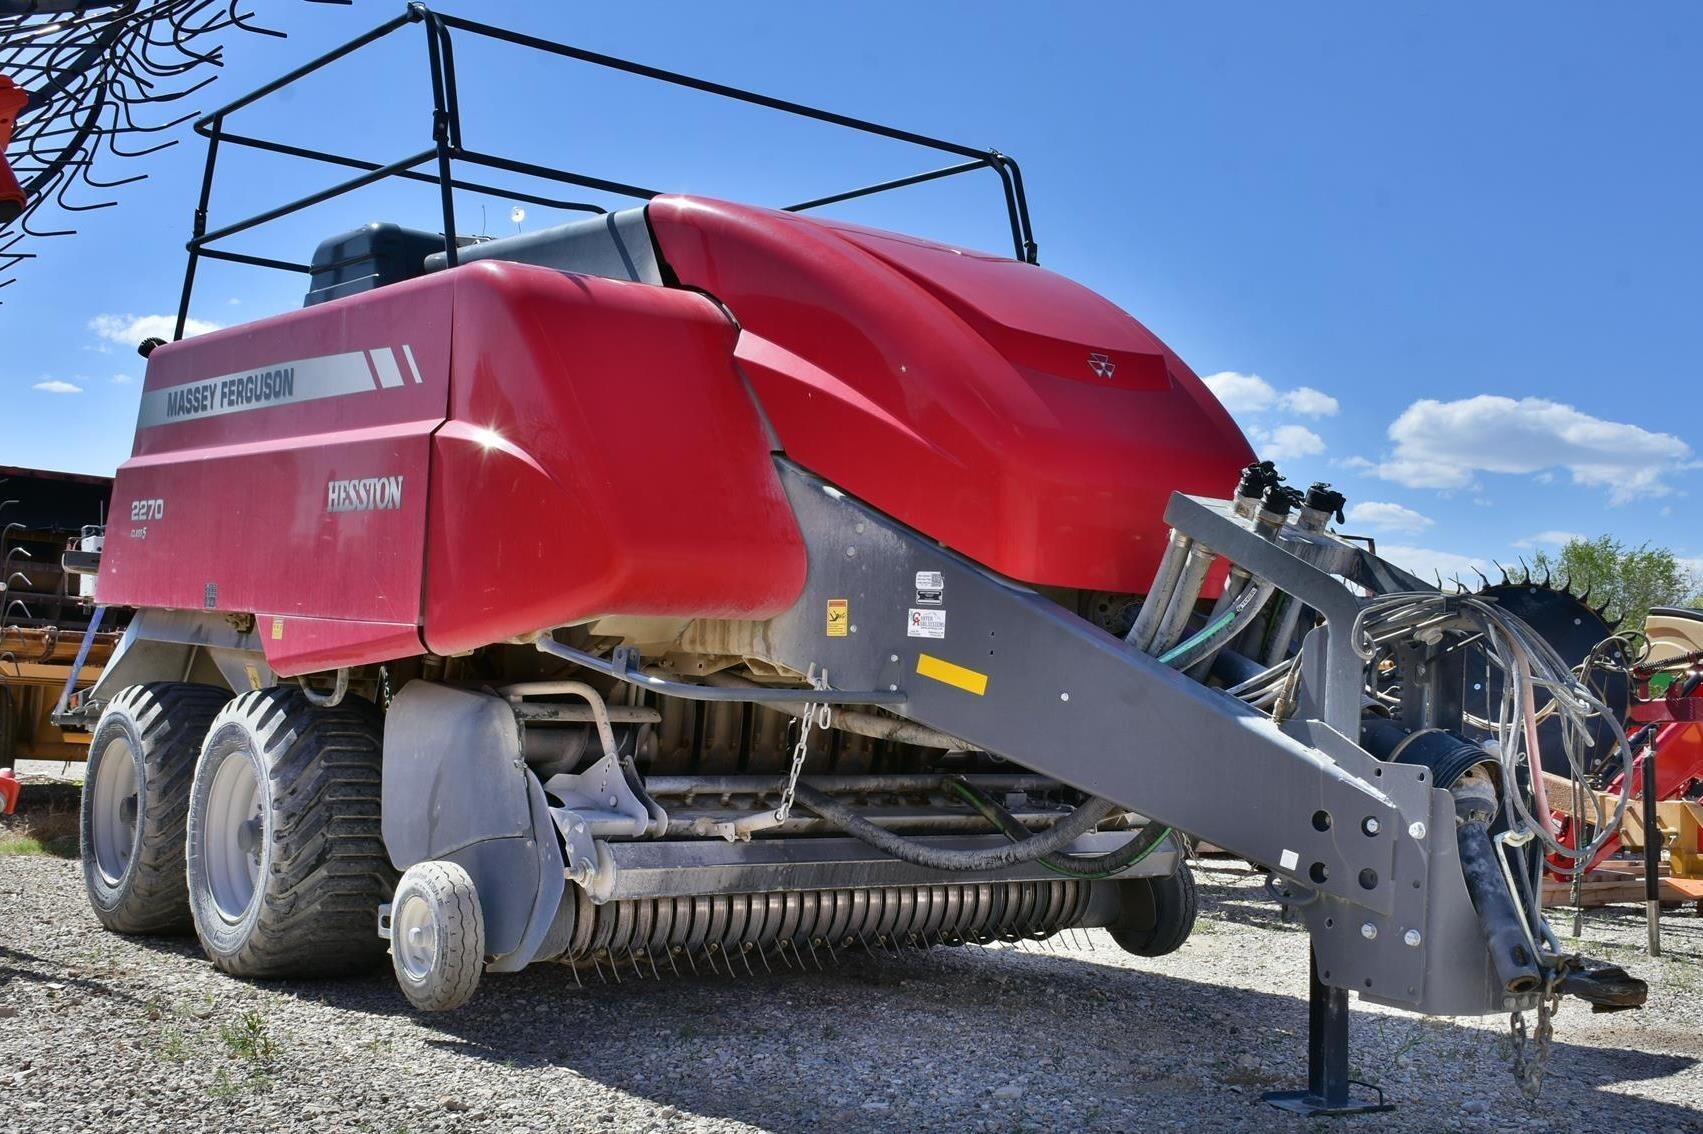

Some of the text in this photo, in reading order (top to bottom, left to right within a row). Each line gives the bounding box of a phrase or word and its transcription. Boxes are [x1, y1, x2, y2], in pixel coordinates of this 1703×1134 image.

[167, 368, 294, 417] MASSEY FERGUSON
[131, 499, 164, 520] 2270
[327, 475, 403, 512] HESSTON
